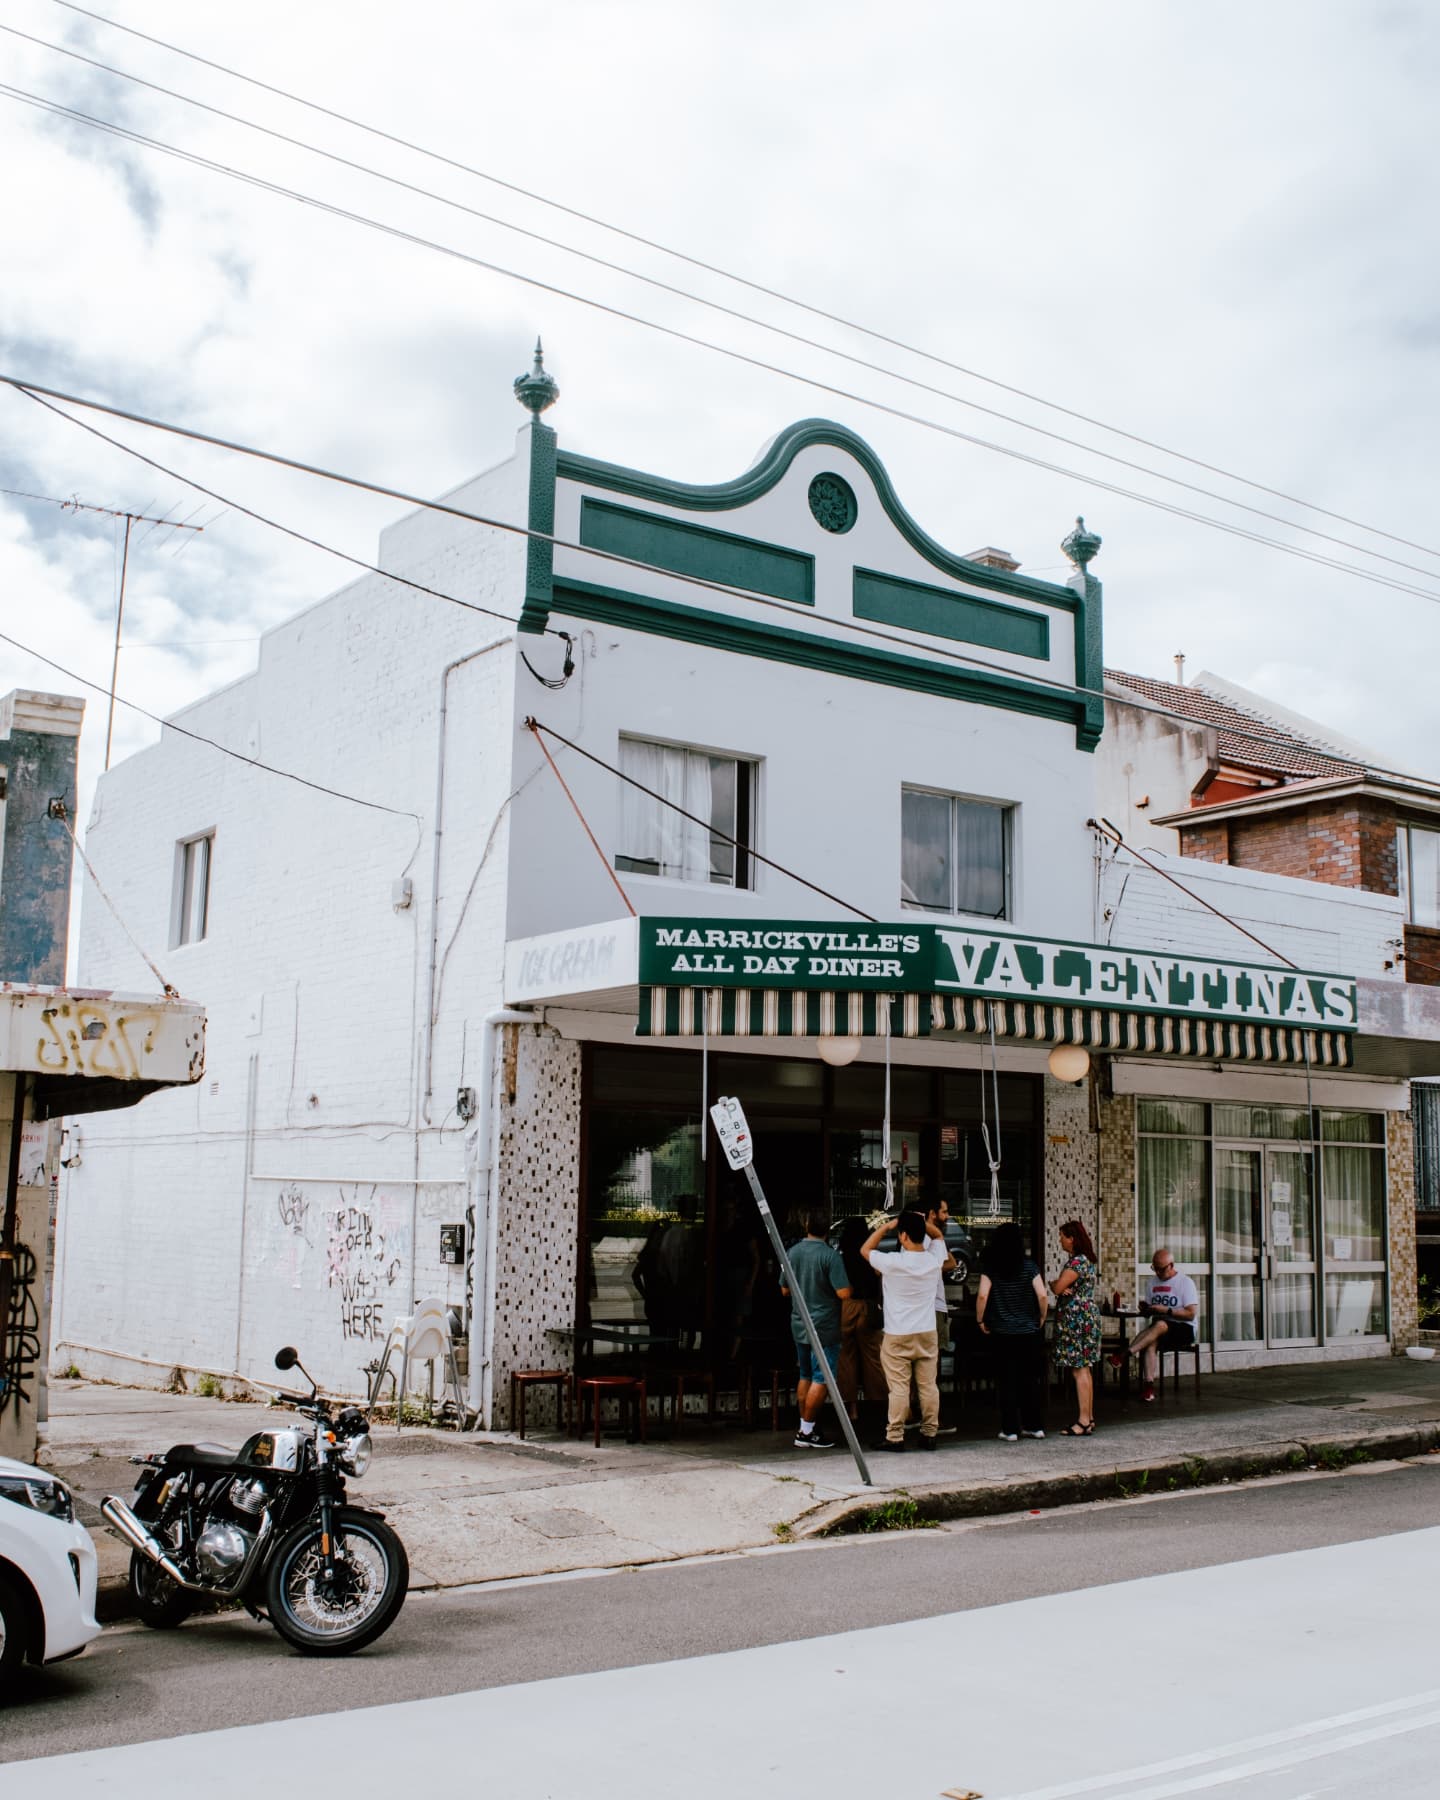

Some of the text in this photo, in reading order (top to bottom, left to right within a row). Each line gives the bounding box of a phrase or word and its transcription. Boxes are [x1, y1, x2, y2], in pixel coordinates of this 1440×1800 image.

[655, 928, 921, 953] MARRICKVILLE'S
[671, 953, 905, 978] ALL DAY DINER
[935, 929, 1356, 1027] VALENTINAS
[341, 1303, 386, 1342] HERE
